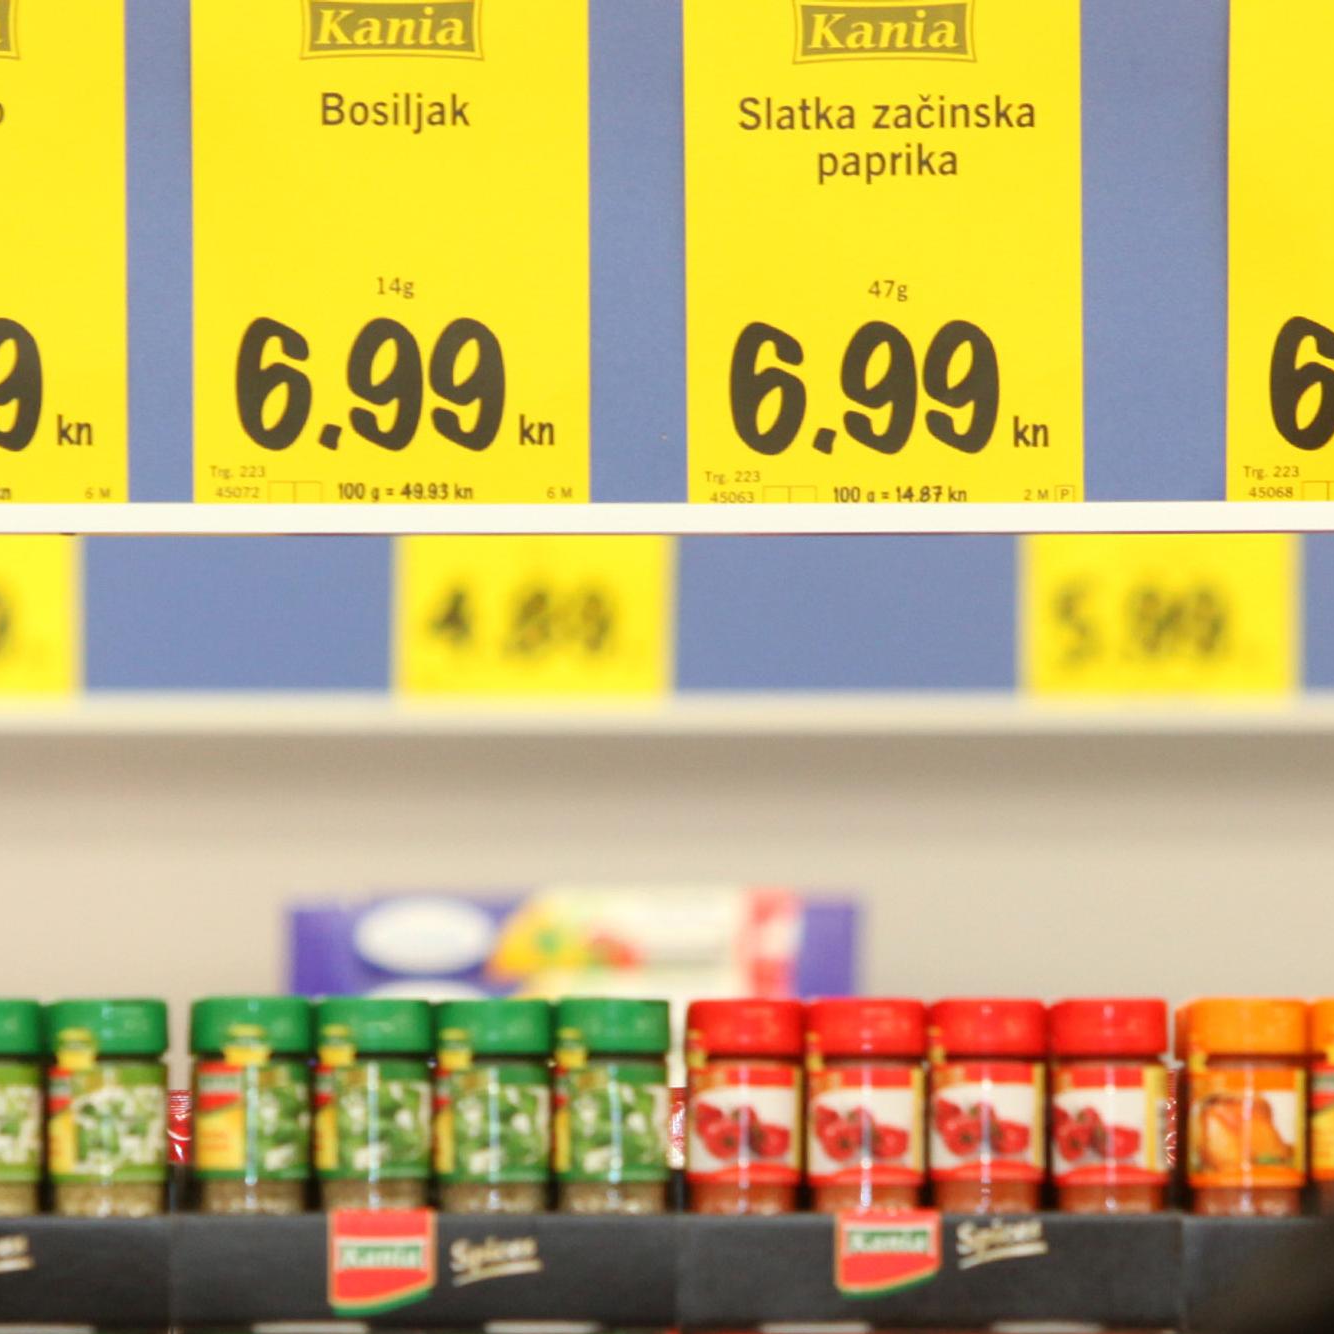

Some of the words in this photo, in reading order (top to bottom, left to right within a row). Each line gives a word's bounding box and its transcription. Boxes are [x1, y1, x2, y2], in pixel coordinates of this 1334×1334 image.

[313, 6, 465, 46] Kania
[807, 9, 959, 51] Kania
[322, 93, 469, 134] Bosiljak
[739, 97, 854, 130] Slatka
[873, 95, 1035, 129] začinska
[819, 143, 957, 184] paprika
[378, 277, 414, 299] 14g
[868, 280, 907, 302] 47g
[236, 317, 505, 451] 6.99
[520, 414, 554, 445] kn
[730, 320, 999, 455] 6.99
[1014, 416, 1048, 447] kn
[58, 415, 92, 445] kn
[209, 464, 234, 481] Trg.
[239, 465, 266, 479] 223
[704, 470, 729, 486] Trg.
[734, 470, 761, 483] 223
[1242, 465, 1268, 481] Trg.
[1272, 465, 1300, 478] 223
[84, 486, 95, 500] 6
[98, 487, 111, 499] M
[215, 486, 260, 499] 45072
[338, 482, 366, 501] 100
[399, 482, 449, 500] 49.93
[453, 483, 474, 500] kn
[546, 486, 556, 500] 6
[560, 486, 573, 499] M
[709, 490, 755, 504] 45063
[833, 485, 861, 504] 100
[895, 485, 943, 504] 14.87
[947, 485, 968, 503] kn
[1023, 488, 1033, 502] 2
[1037, 488, 1049, 501] M
[1060, 488, 1070, 500] P
[1248, 486, 1294, 499] 45068
